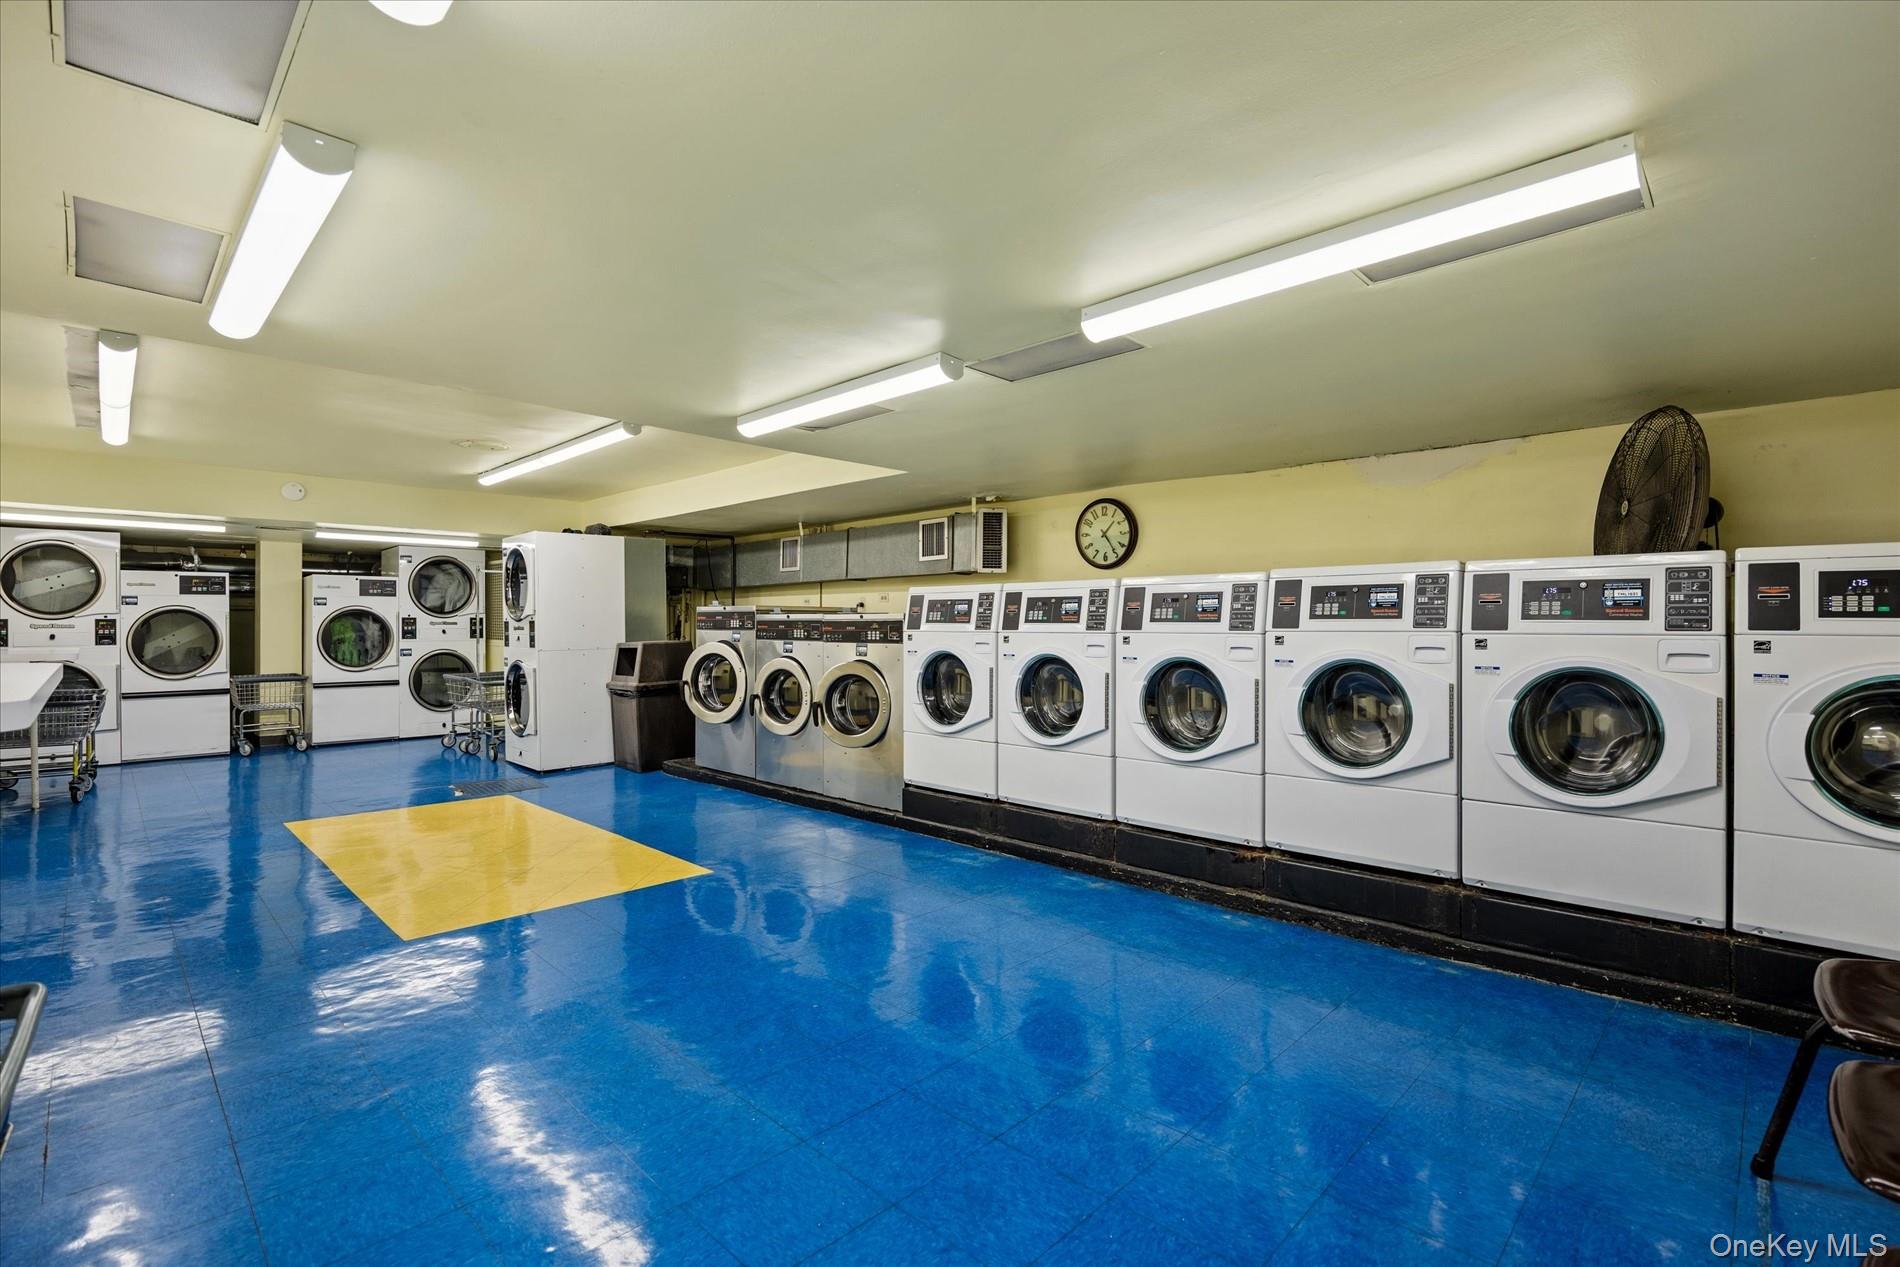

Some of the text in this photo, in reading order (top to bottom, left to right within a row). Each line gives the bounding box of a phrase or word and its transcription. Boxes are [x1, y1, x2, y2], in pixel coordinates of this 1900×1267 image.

[1091, 509, 1099, 520] 11
[1101, 506, 1108, 516] 12
[1111, 509, 1117, 518] 1
[1092, 549, 1100, 559] 7
[1103, 552, 1108, 562] 6
